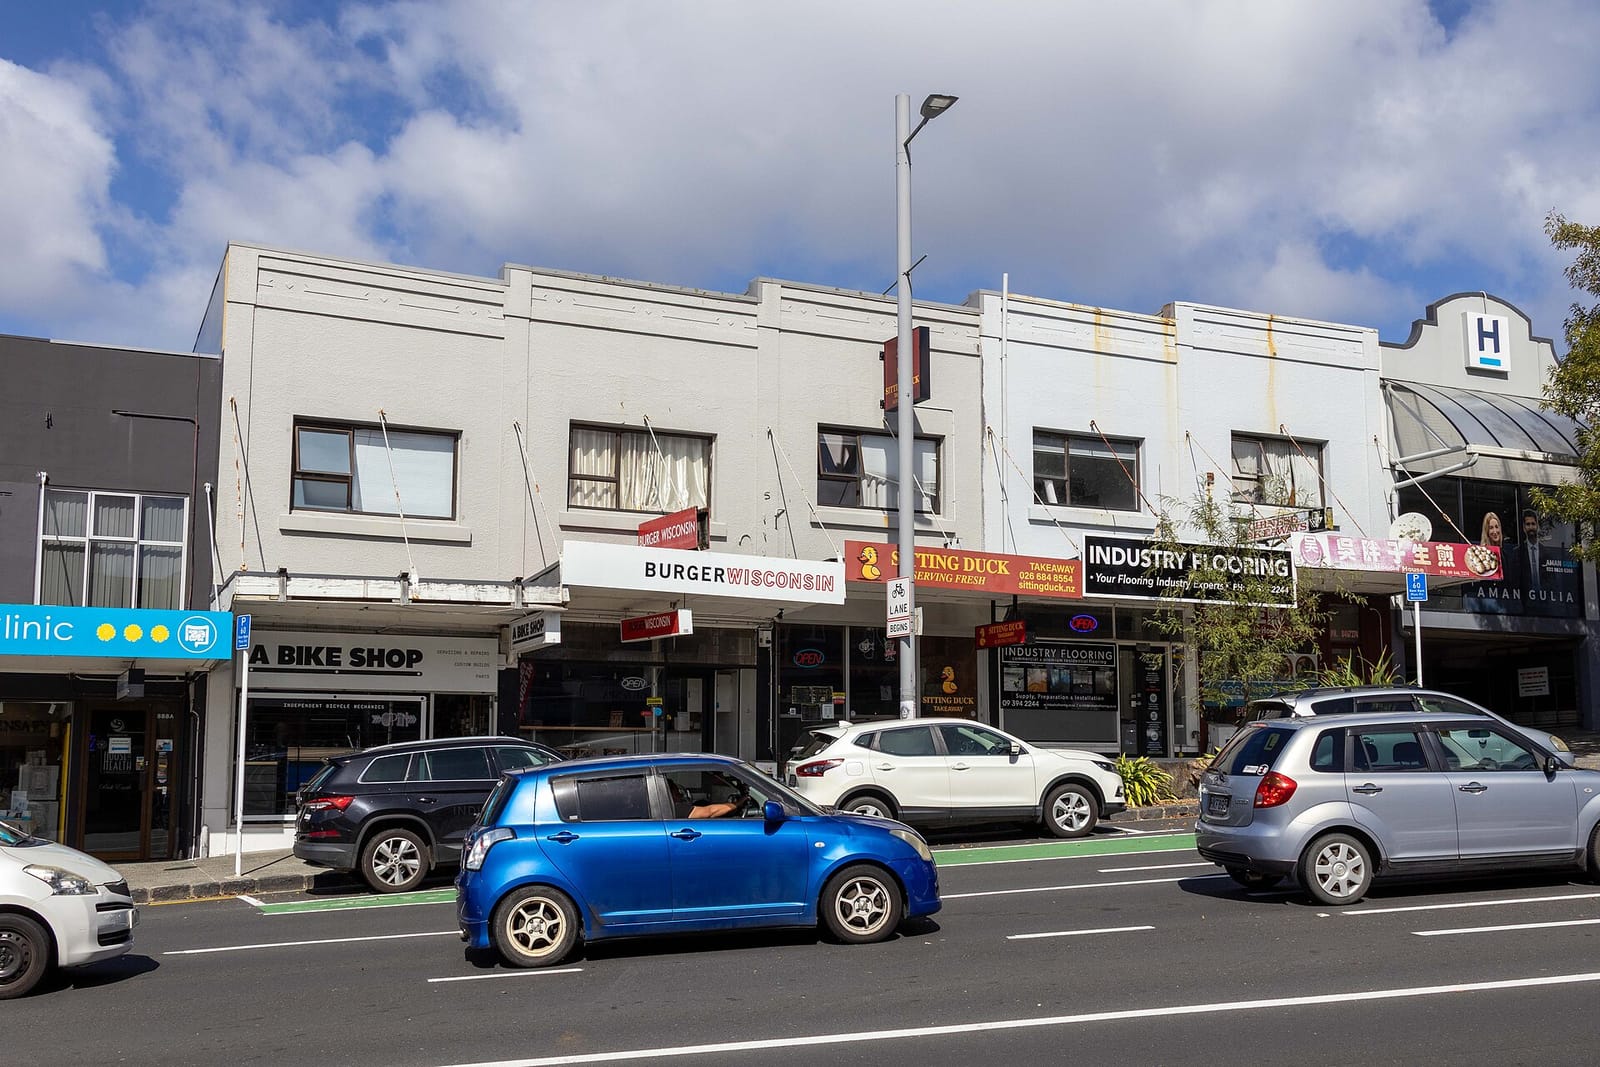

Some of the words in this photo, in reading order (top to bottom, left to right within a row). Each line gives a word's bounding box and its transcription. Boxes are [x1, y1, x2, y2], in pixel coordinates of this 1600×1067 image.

[1477, 317, 1500, 353] H
[661, 521, 696, 541] WISCONSIN
[963, 556, 1010, 575] DUCK
[1029, 562, 1075, 574] TAKEAWAY
[1089, 545, 1187, 570] INDUSTRY
[1192, 551, 1289, 577] FLOORING
[955, 574, 986, 585] FRESH
[1019, 572, 1035, 581] 026
[1036, 573, 1052, 582] 684
[1053, 574, 1073, 583] 8554
[1096, 573, 1116, 584] Your
[1118, 574, 1154, 588] Flooring
[1156, 578, 1190, 591] Industry
[1412, 574, 1420, 582] P
[1018, 580, 1076, 593] sittingduck.nz
[1477, 586, 1520, 600] AMAN
[1528, 589, 1574, 603] GULIA
[889, 603, 908, 615] LANE
[0, 614, 74, 641] linic
[512, 627, 517, 640] A
[517, 622, 530, 638] BIKE
[530, 618, 545, 635] SHOP
[890, 622, 908, 633] BEGINS
[249, 644, 269, 665] A
[277, 645, 342, 667] BIKE
[349, 647, 423, 668] SHOP
[1005, 647, 1057, 658] INDUSTRY
[1061, 649, 1113, 660] FLOORING
[922, 696, 952, 704] SITTING
[953, 697, 975, 705] DUCK
